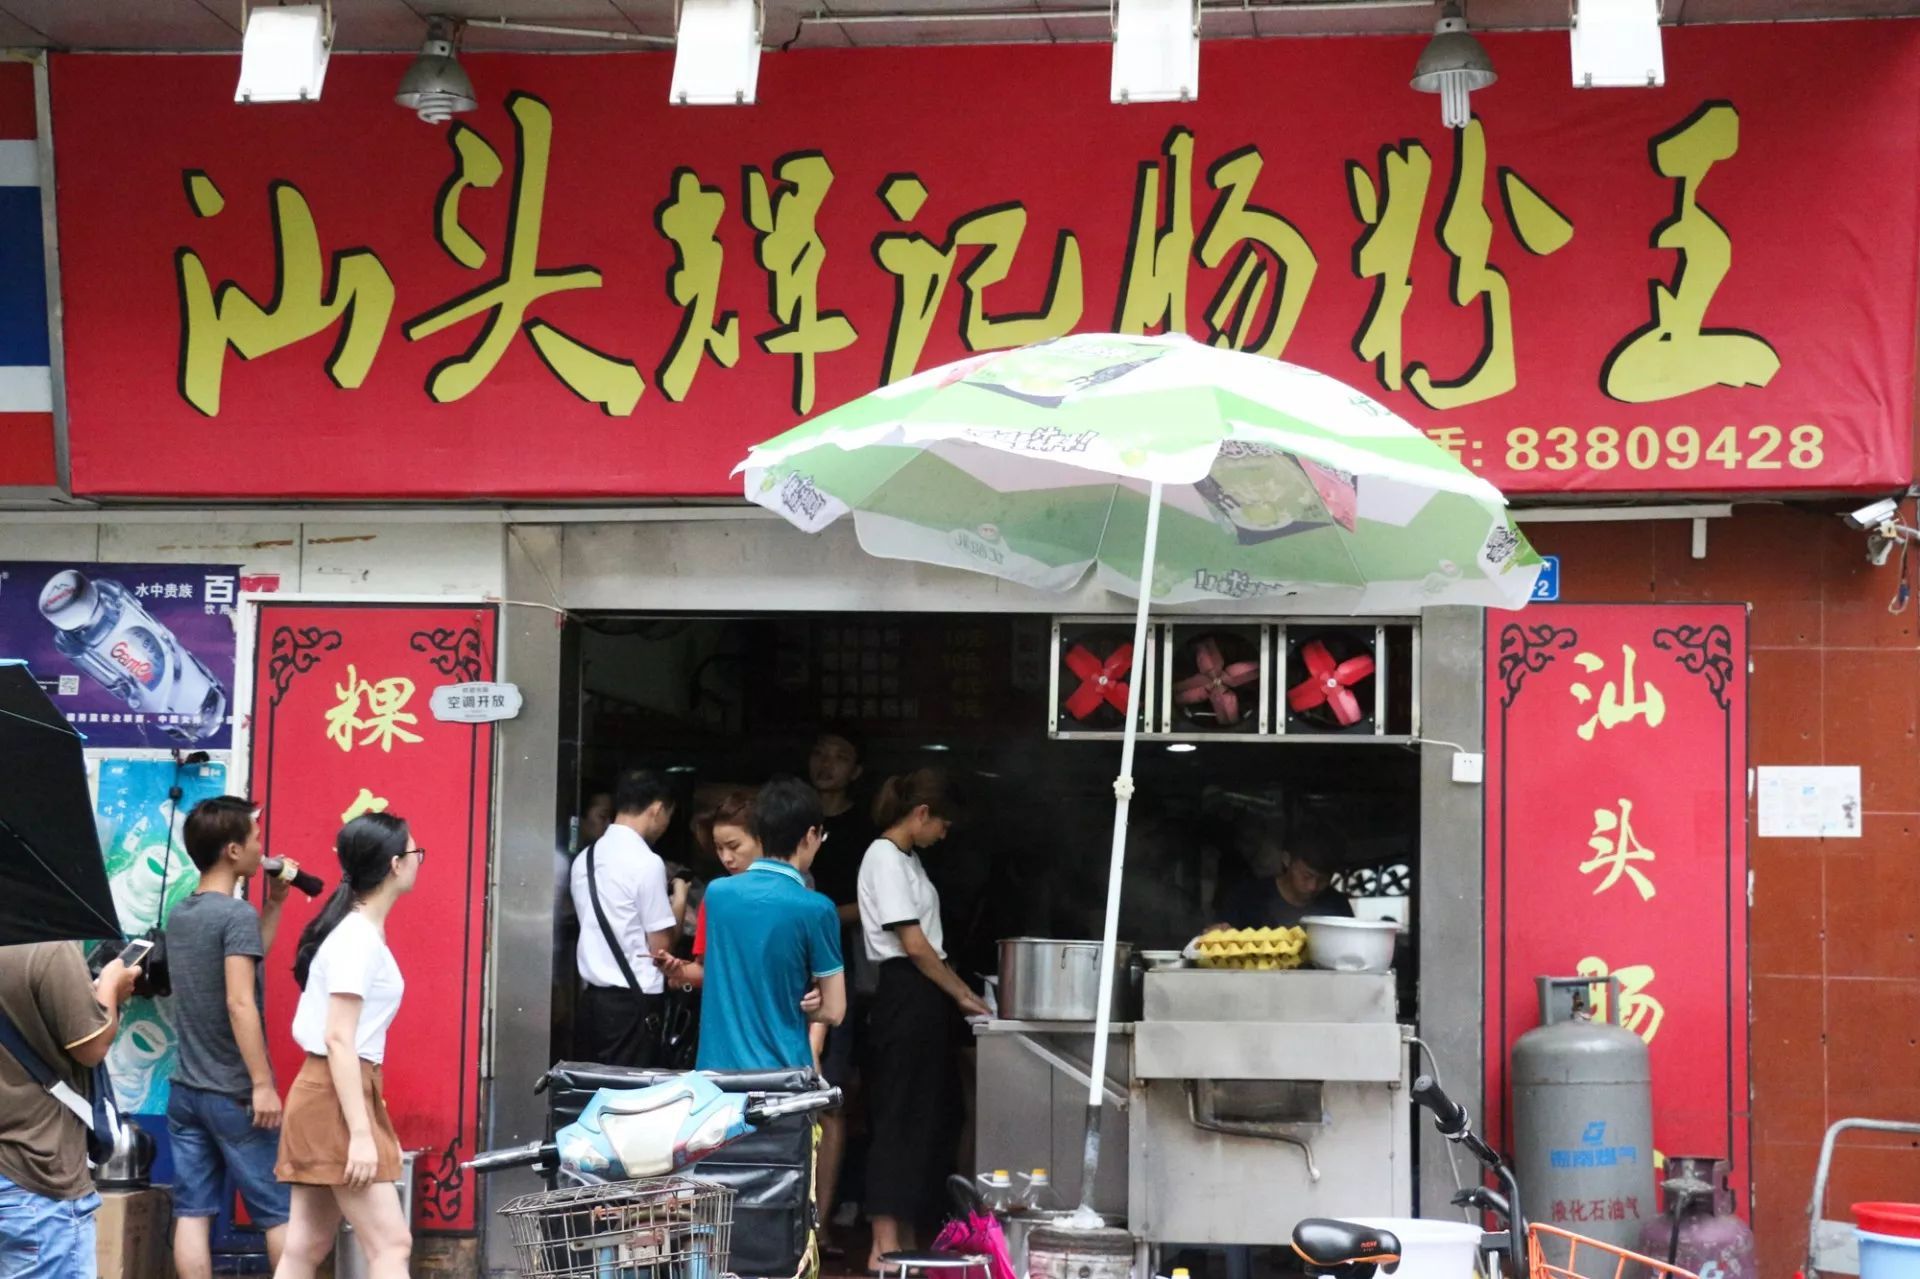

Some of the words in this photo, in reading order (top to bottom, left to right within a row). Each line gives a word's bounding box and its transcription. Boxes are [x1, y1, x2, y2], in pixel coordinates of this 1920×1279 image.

[1504, 424, 1825, 471] 83809428
[135, 582, 193, 598] 水中贵族
[204, 575, 235, 603] 百
[447, 695, 505, 709] 空调开放
[1551, 1196, 1640, 1223] 液化石油气
